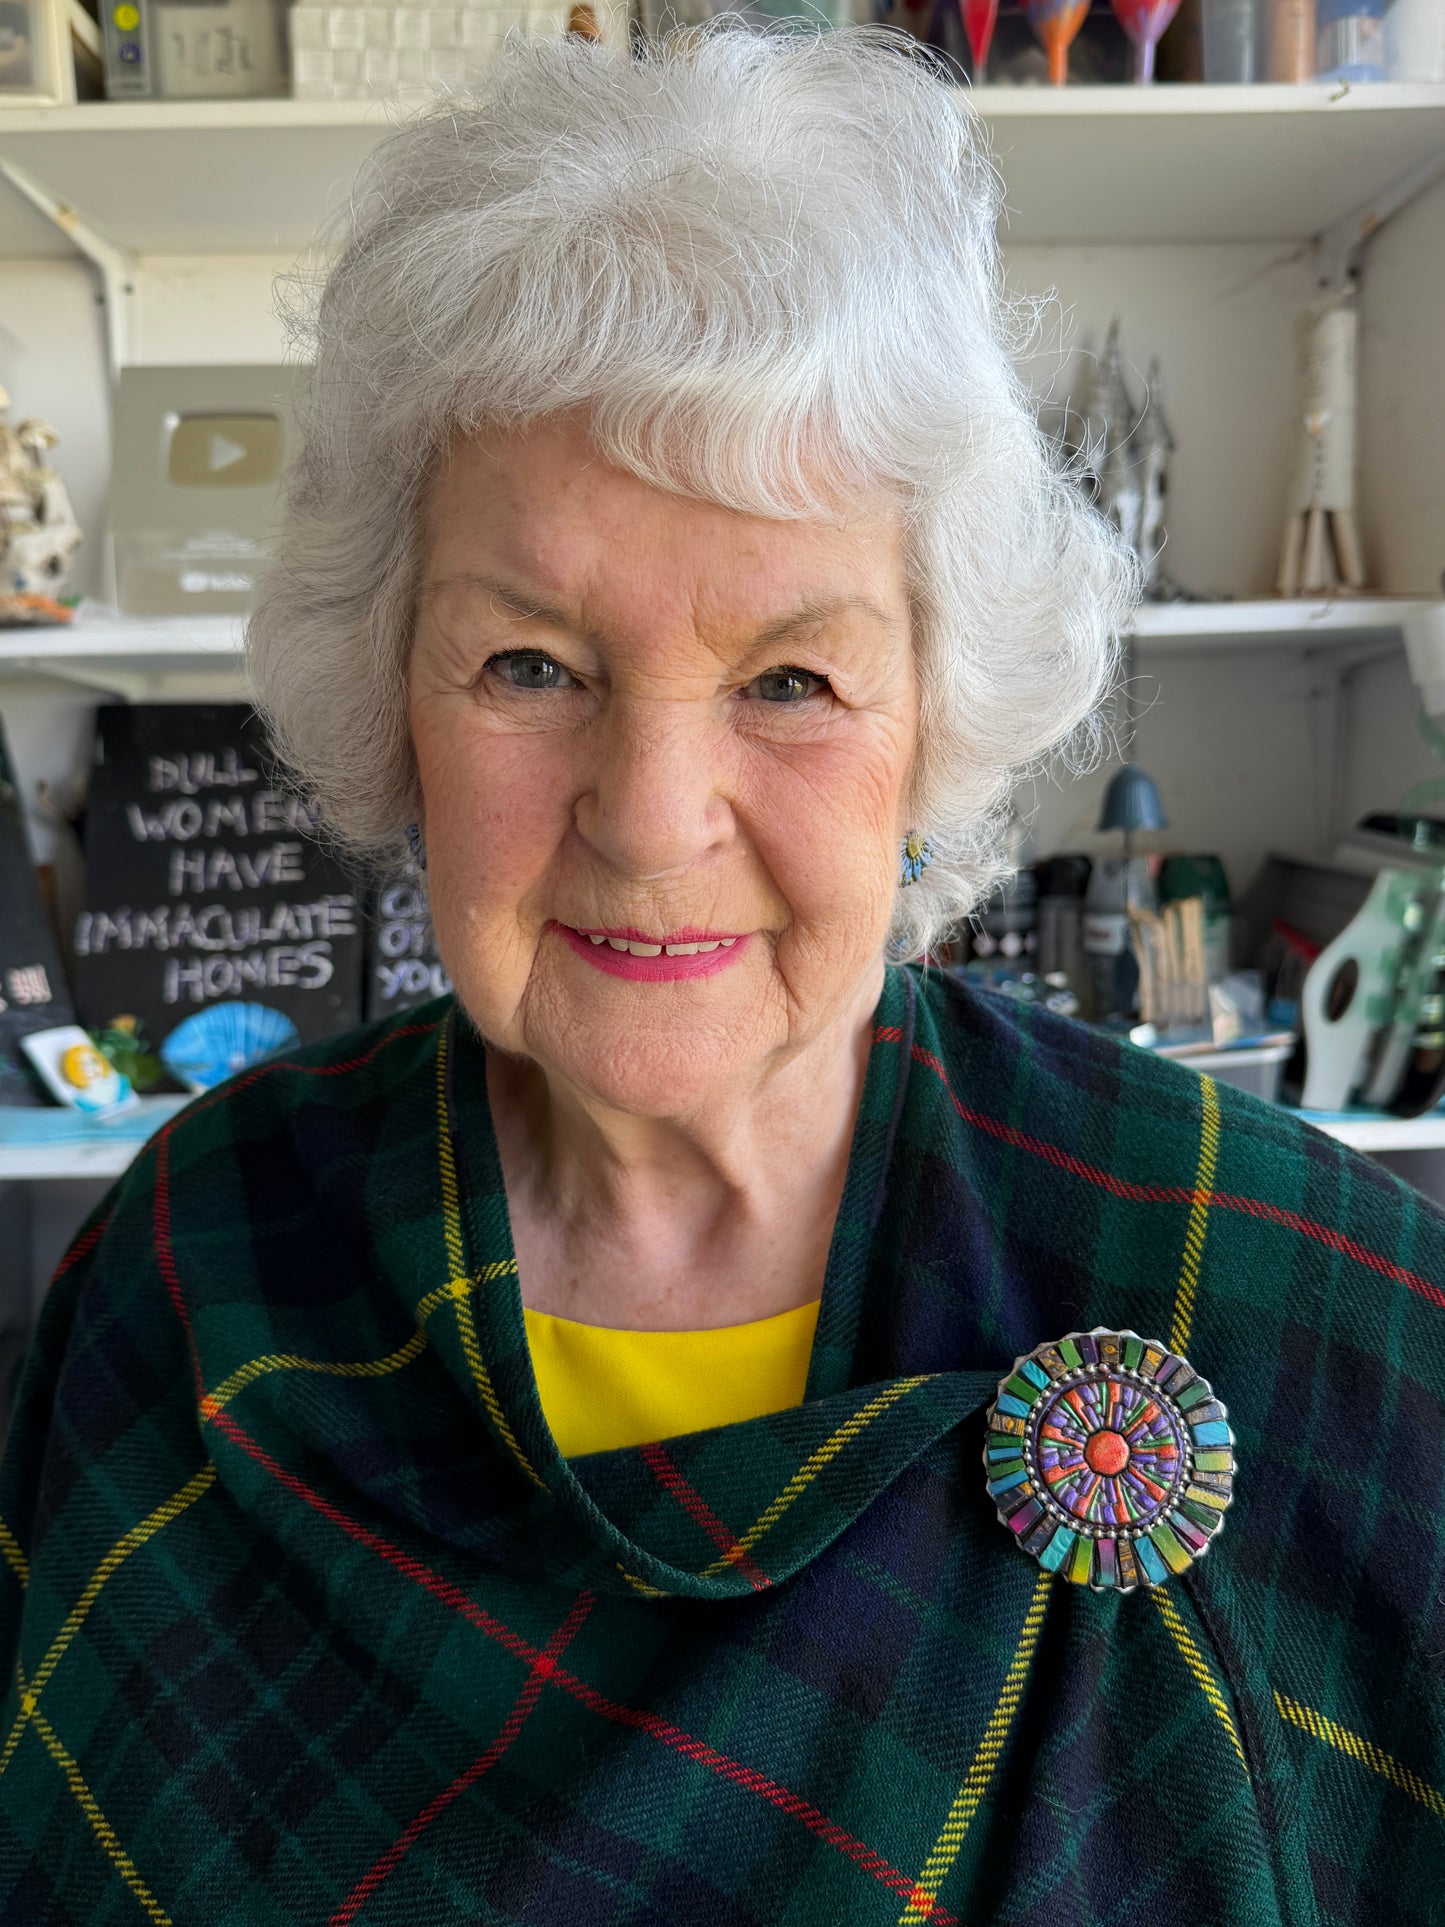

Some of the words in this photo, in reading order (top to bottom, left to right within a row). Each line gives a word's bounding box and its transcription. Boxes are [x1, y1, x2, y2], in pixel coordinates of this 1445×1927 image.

[169, 842, 305, 895] HAVE
[75, 895, 357, 955] IMMACULATE
[163, 941, 333, 1003] HOMES
